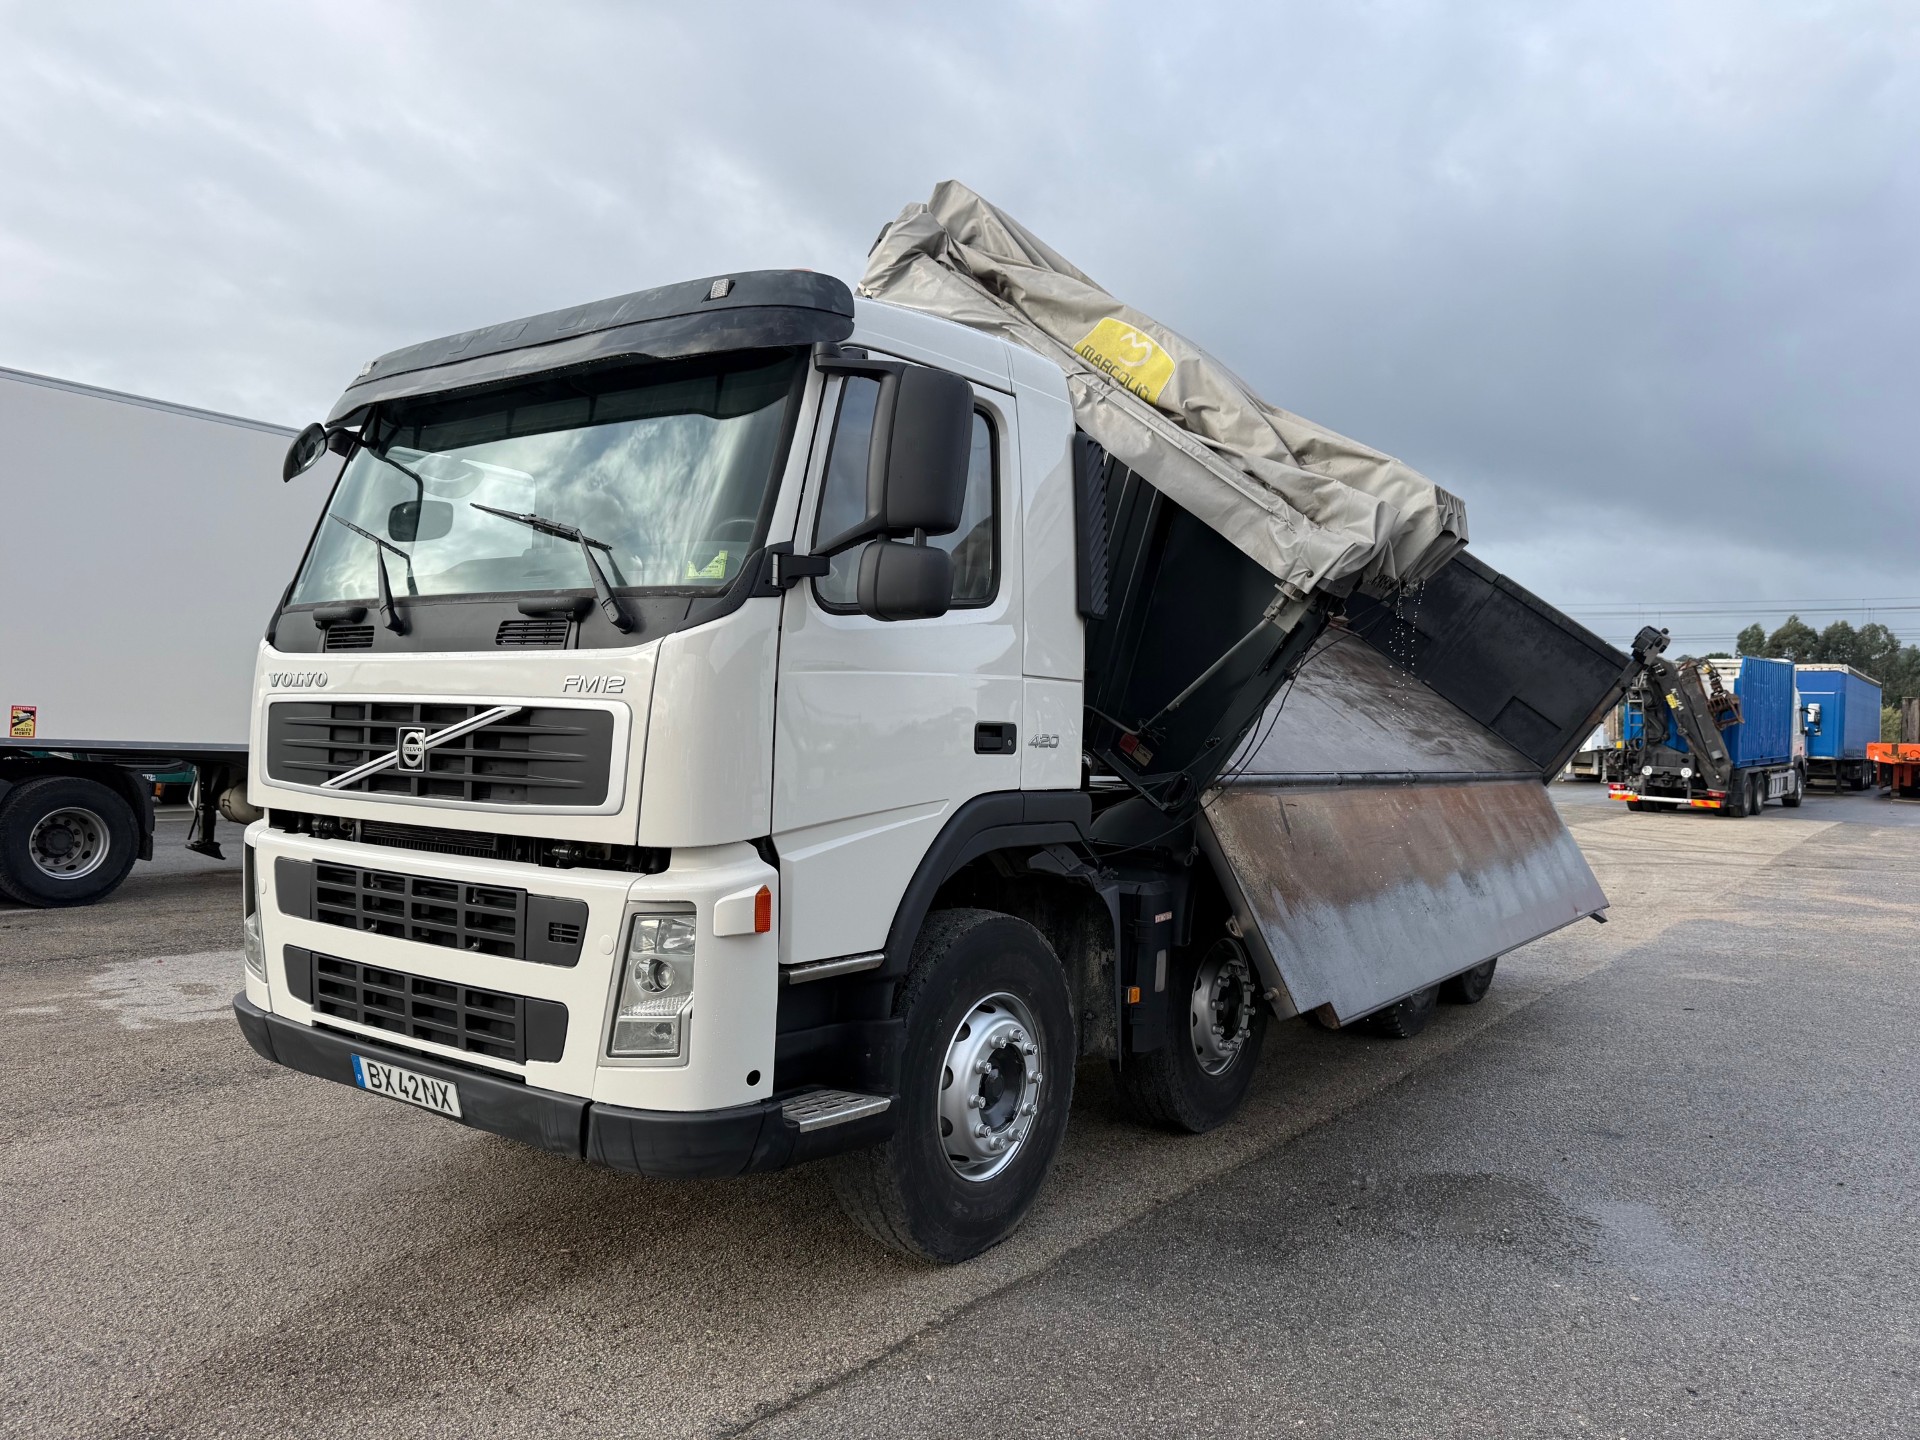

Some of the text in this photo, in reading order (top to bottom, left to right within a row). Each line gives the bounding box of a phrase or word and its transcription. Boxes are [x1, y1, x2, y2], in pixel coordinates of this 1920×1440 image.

[269, 672, 328, 687] VOLVO
[562, 675, 626, 693] FM12
[1028, 734, 1059, 748] 420
